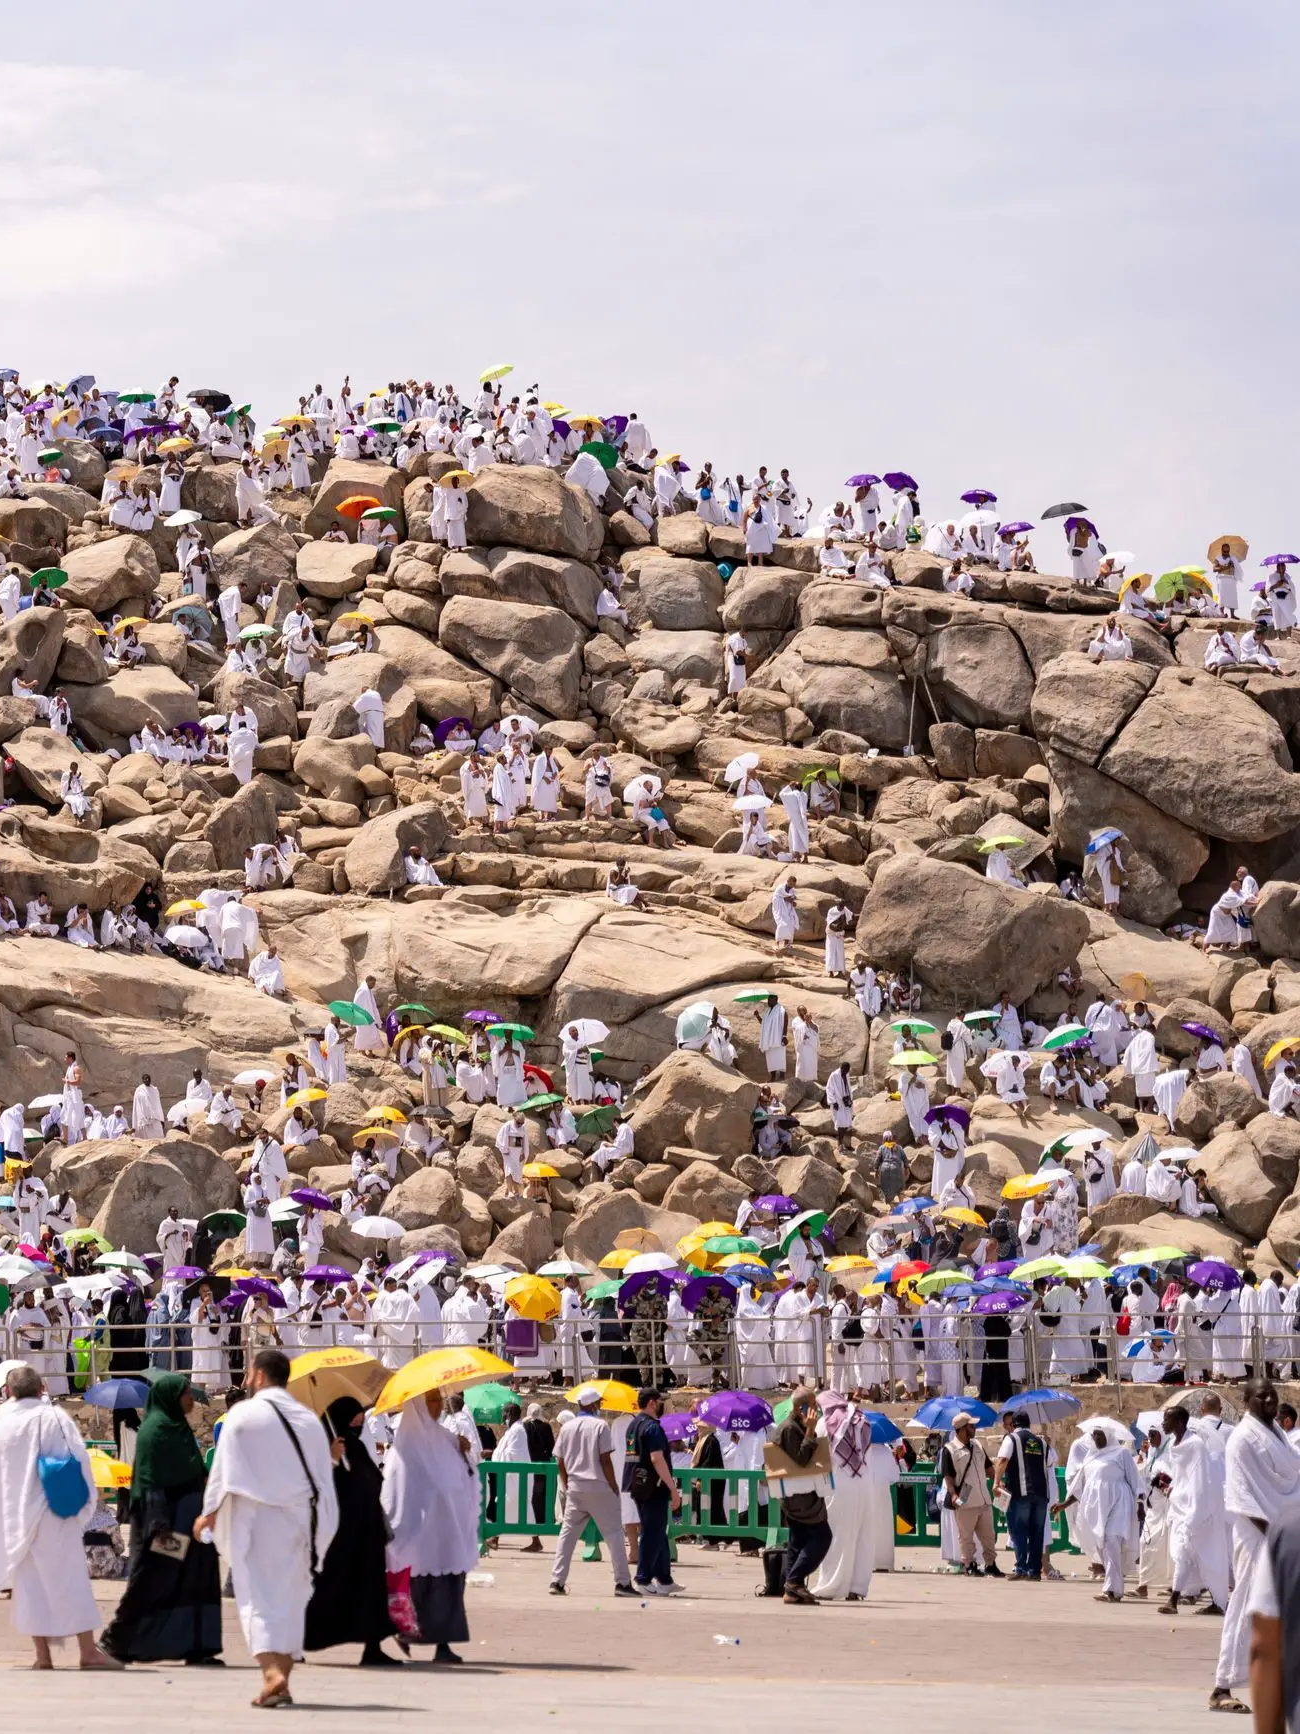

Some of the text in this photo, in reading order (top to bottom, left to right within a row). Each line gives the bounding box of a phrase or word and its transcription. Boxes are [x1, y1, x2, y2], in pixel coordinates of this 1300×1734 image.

[1209, 1278, 1224, 1288] stc
[992, 1302, 1006, 1310] stc
[545, 1308, 560, 1319] DHL
[732, 1418, 750, 1428] stc
